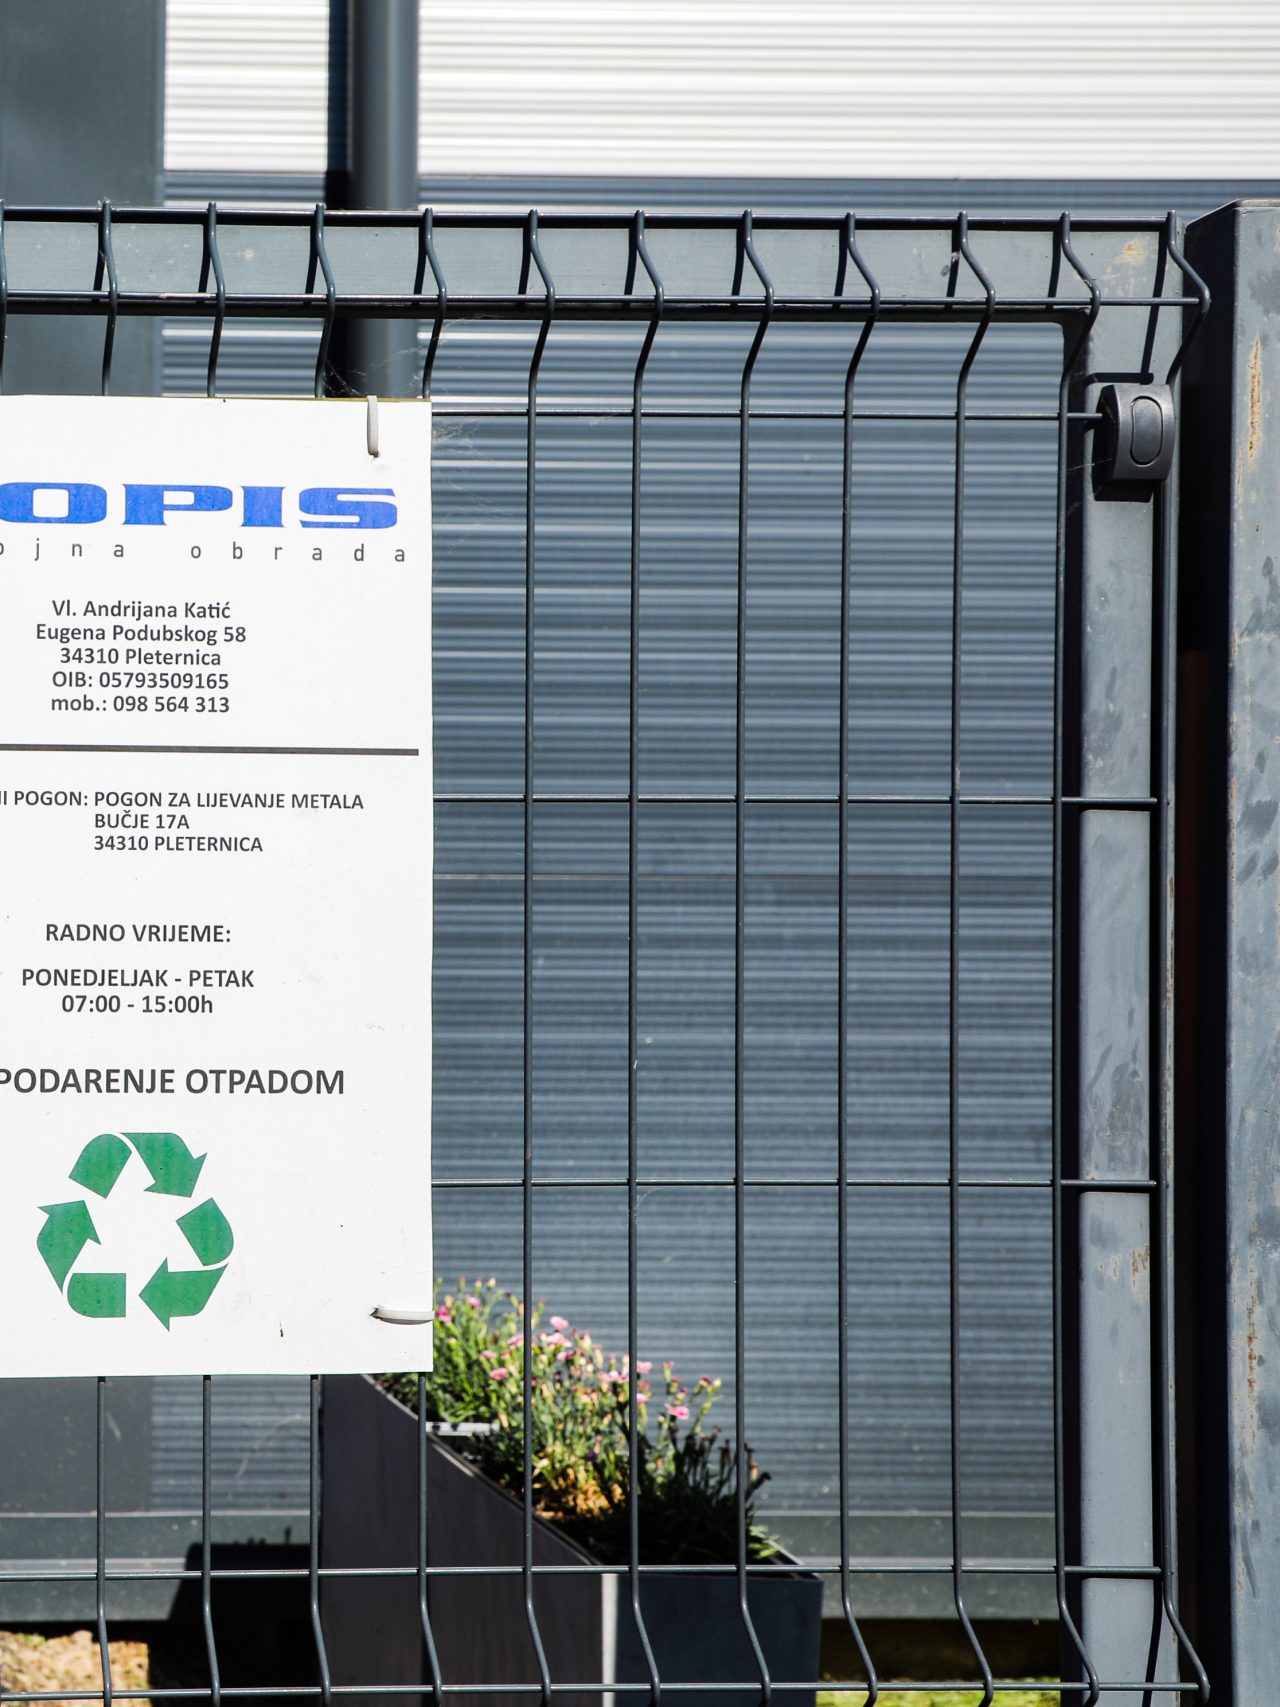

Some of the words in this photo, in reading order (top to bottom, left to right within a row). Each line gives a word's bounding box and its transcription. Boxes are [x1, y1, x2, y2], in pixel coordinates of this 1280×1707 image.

[82, 599, 177, 622] Andrijana
[184, 601, 231, 619] Katić
[36, 623, 106, 644] Eugena
[112, 624, 218, 646] Podubskog
[223, 626, 247, 643] 58
[60, 647, 119, 665] 34310
[125, 647, 221, 666] Pleternica
[52, 670, 93, 688] OIB:
[99, 671, 229, 690] 05793509165
[51, 693, 107, 712] mob.:
[113, 695, 148, 712] 098
[154, 696, 190, 713] 564
[195, 696, 230, 713] 313
[14, 790, 88, 806] POGON:
[94, 791, 162, 807] POGON
[167, 792, 191, 808] ZA
[197, 792, 285, 809] LIJEVANJE
[291, 793, 364, 810] METALA
[94, 809, 150, 829] BUČJE
[155, 813, 190, 830] 17A
[94, 835, 149, 851] 34310
[154, 836, 264, 852] PLETERNICA
[46, 923, 126, 942] RADNO
[131, 924, 231, 943] VRIJEME:
[22, 968, 168, 987] PONEDJELJAK
[189, 969, 255, 988] PETAK
[61, 994, 121, 1013] 07:00
[142, 994, 213, 1014] 15:00h
[185, 1068, 344, 1095] OTPADOM
